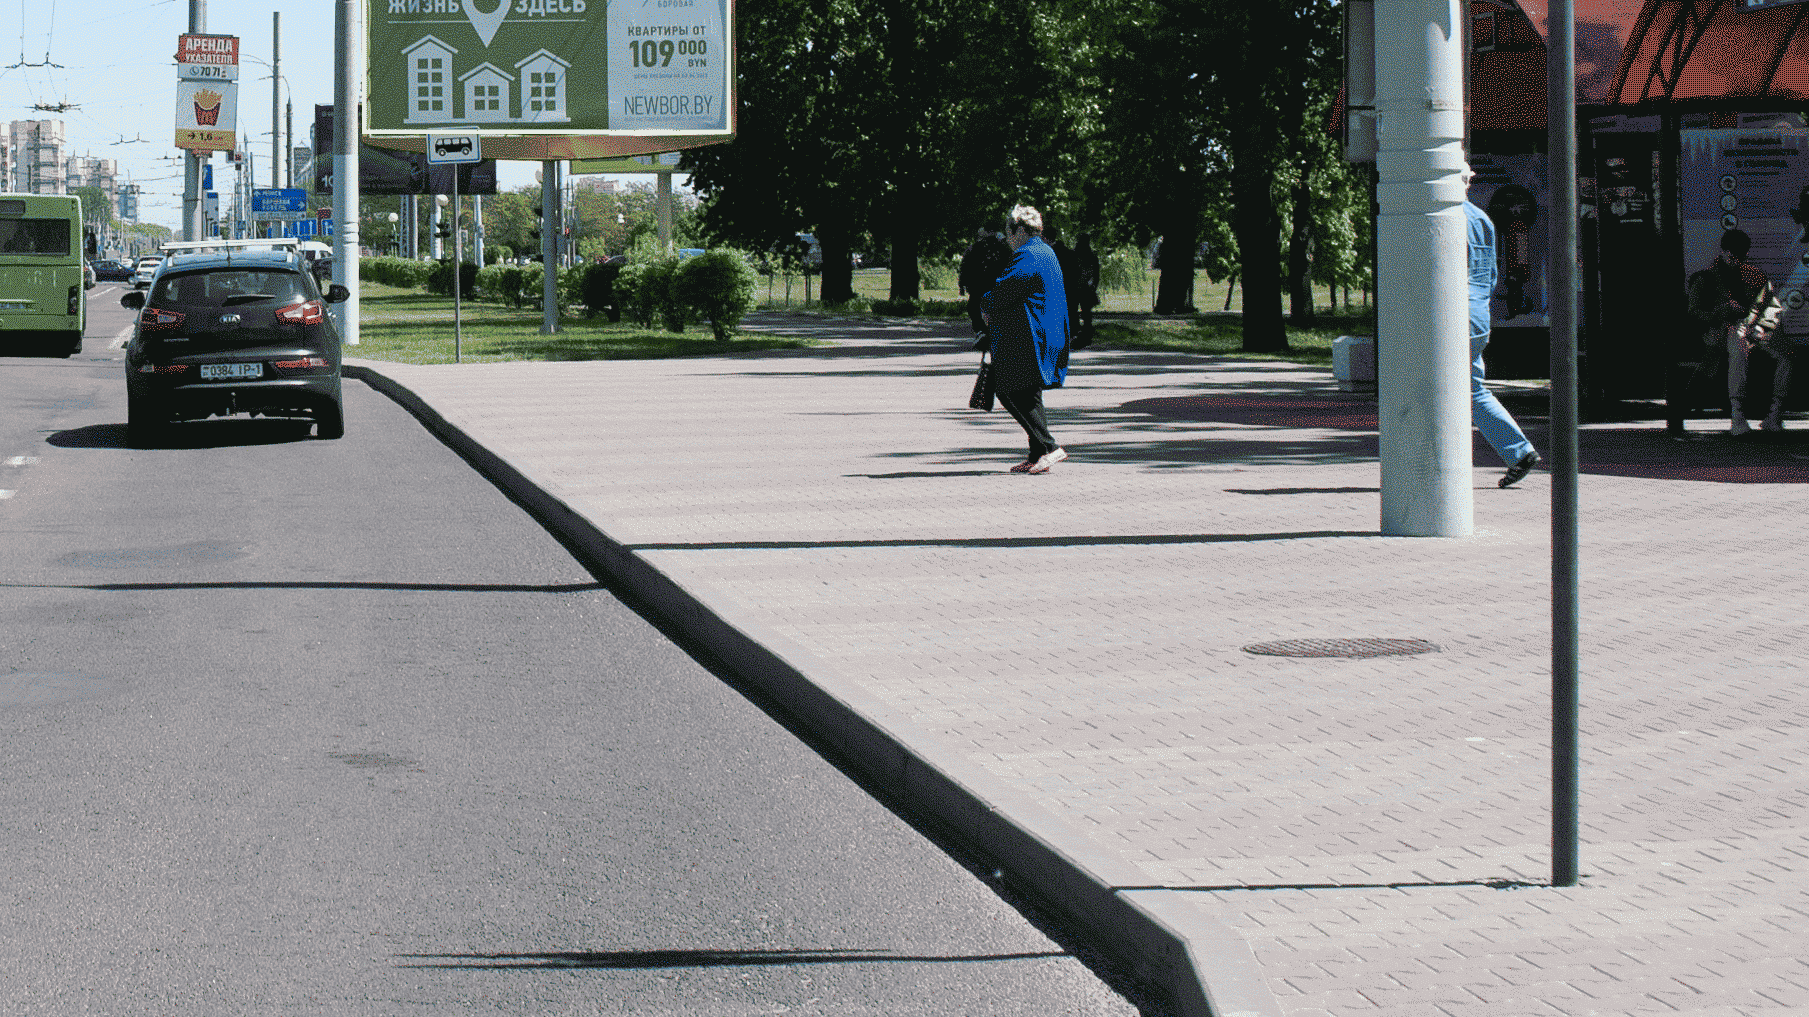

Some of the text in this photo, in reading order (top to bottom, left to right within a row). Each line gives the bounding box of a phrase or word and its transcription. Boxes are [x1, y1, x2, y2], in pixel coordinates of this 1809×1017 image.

[628, 25, 706, 36] КВАРТИРЫ ОТ
[186, 38, 233, 53] АРЕНДА
[185, 53, 233, 65] УКАЗАТЕЛЯ
[629, 40, 707, 68] 109 000
[688, 59, 707, 67] BYN
[200, 66, 211, 76] 70
[212, 66, 221, 77] 71
[624, 96, 713, 115] NEWBOR.BY
[221, 314, 239, 323] KIA
[210, 364, 261, 376] 0384 IP-1
